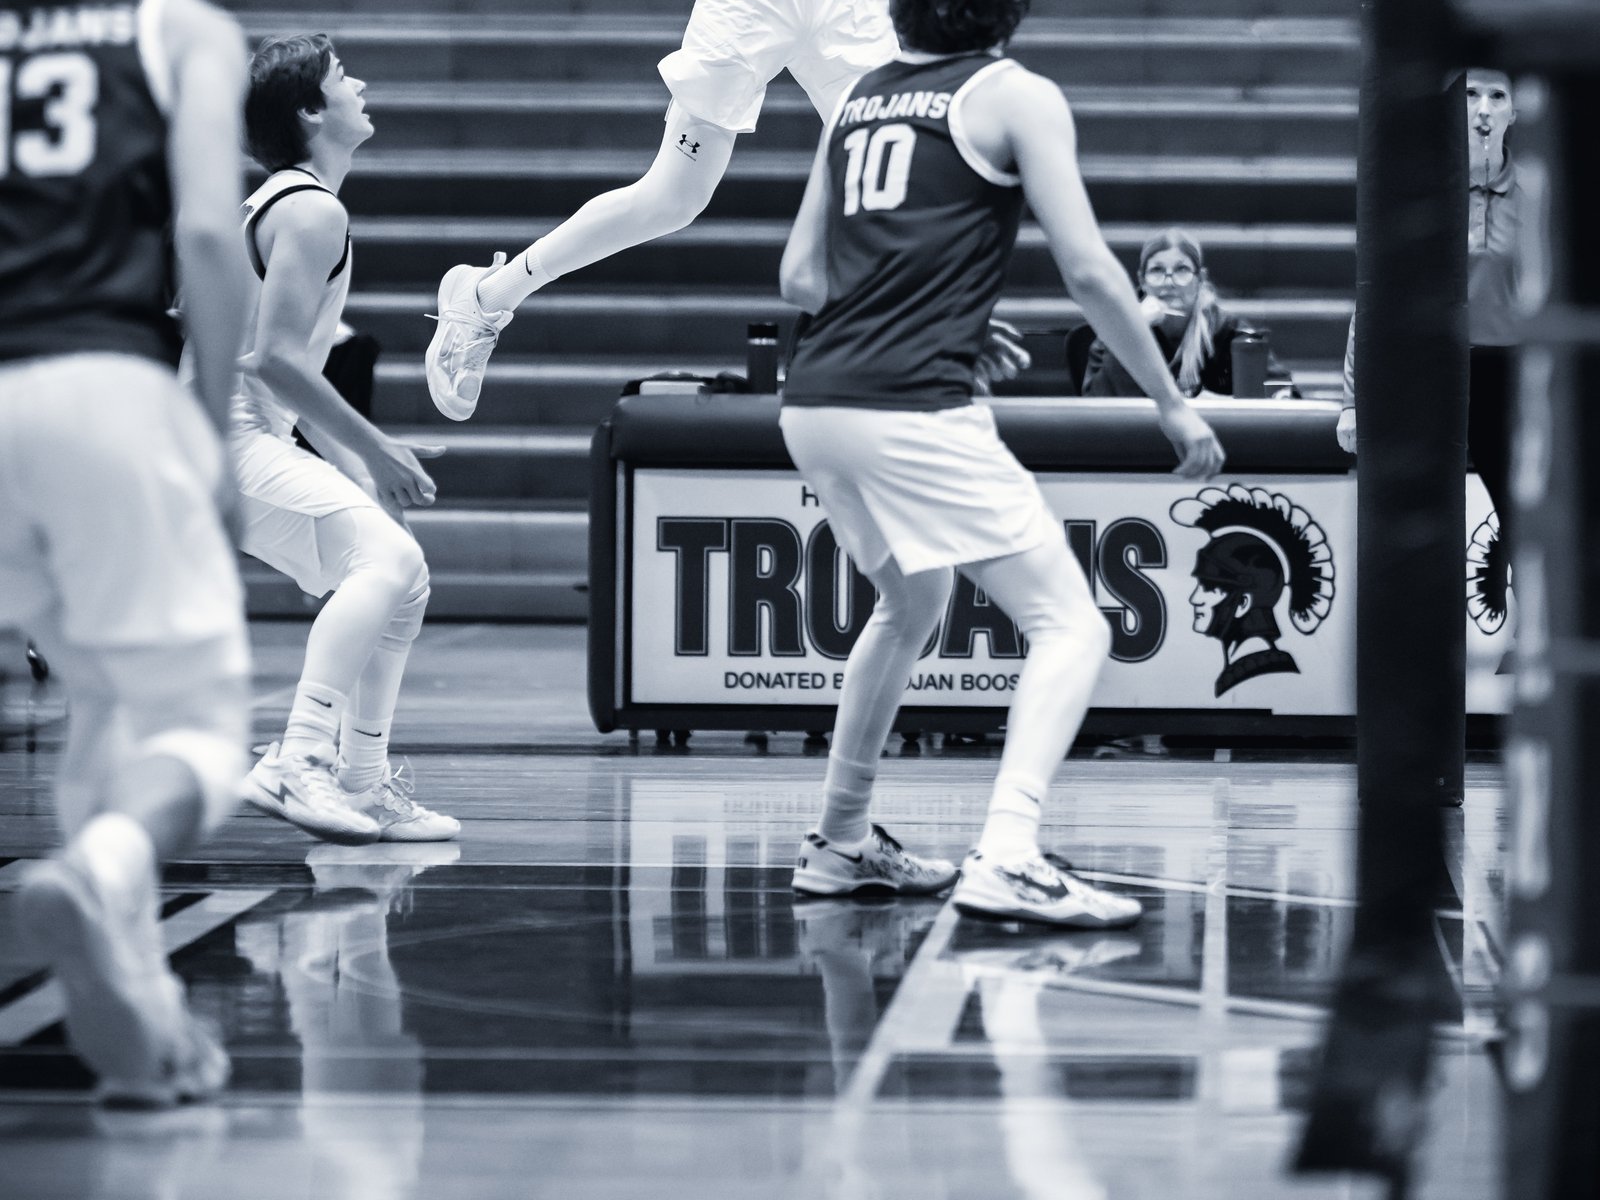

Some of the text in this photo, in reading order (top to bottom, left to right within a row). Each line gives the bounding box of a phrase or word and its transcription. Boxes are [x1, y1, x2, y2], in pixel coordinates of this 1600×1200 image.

[839, 91, 952, 127] TROJANS
[843, 123, 917, 217] 10
[724, 671, 826, 690] DONATED
